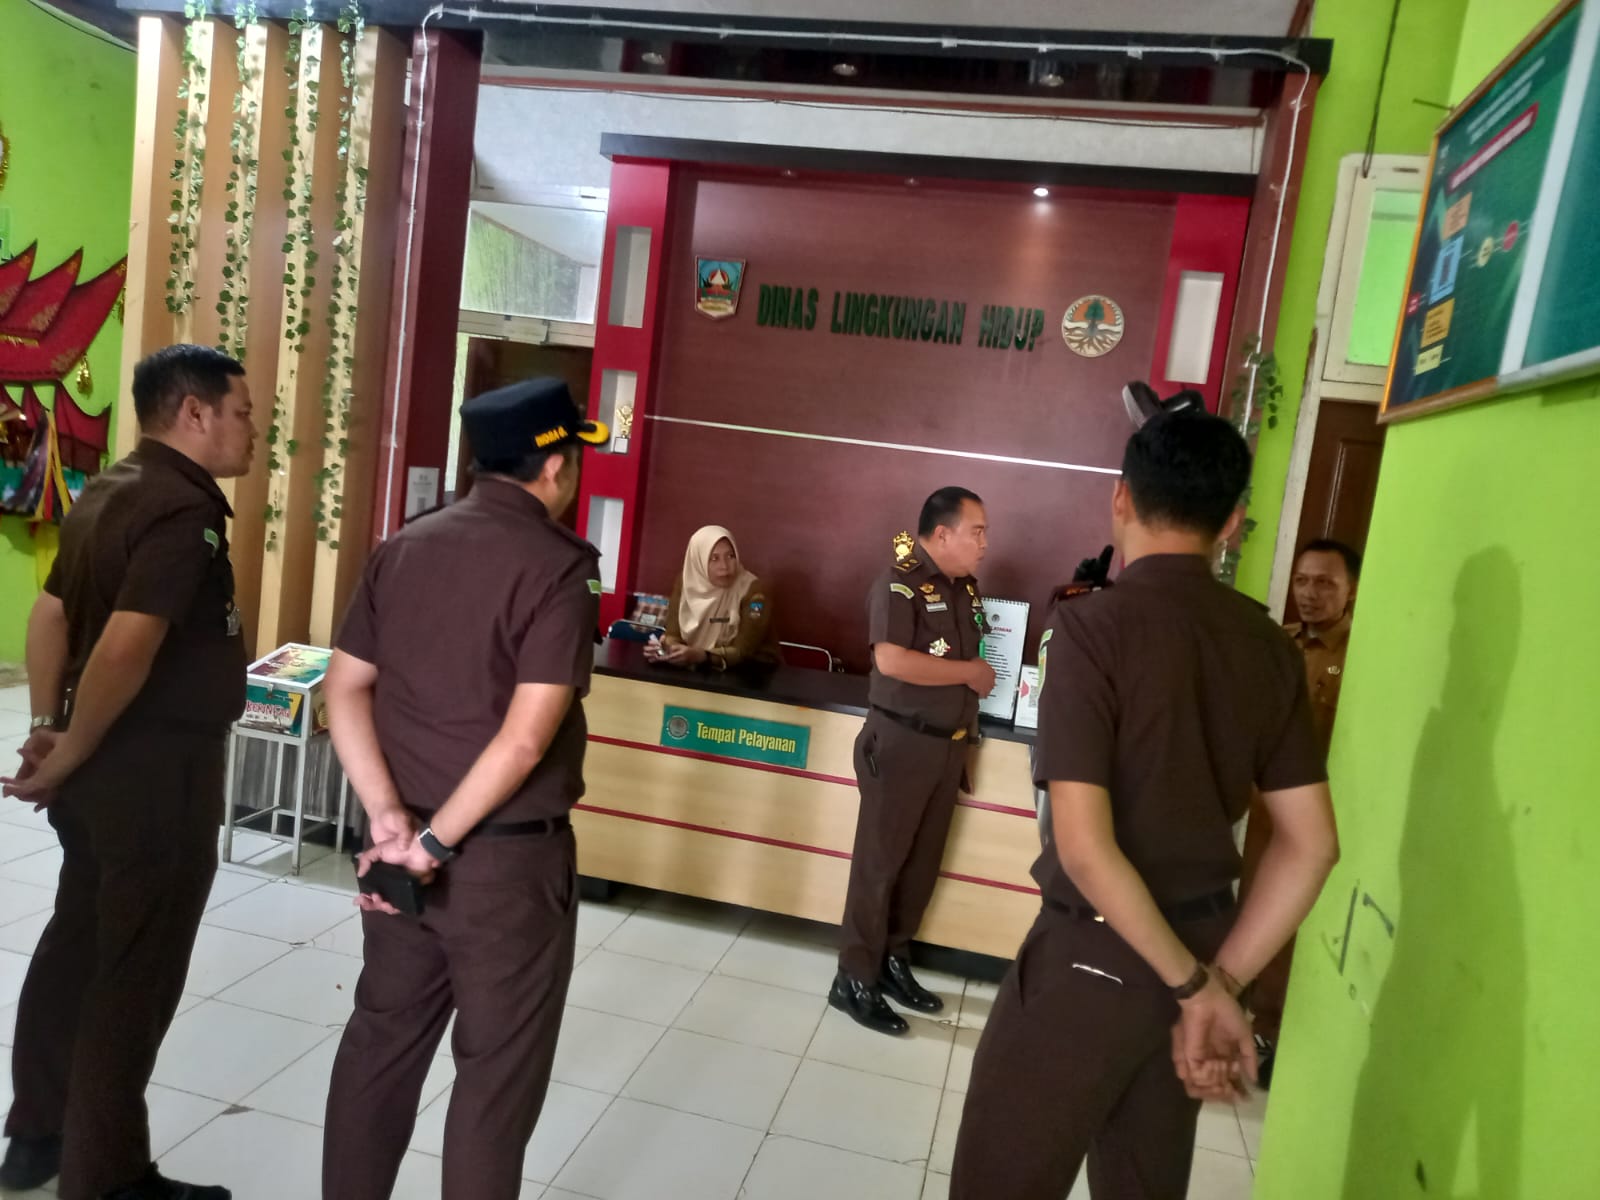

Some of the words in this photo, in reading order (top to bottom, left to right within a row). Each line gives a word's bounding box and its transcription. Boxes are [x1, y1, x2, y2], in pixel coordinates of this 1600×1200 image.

[756, 283, 819, 331] DINAS
[830, 290, 967, 346] LINGKUNGAN
[977, 304, 1045, 352] HIDUP
[696, 721, 736, 744] Tempat
[738, 727, 797, 754] Pelayanan
